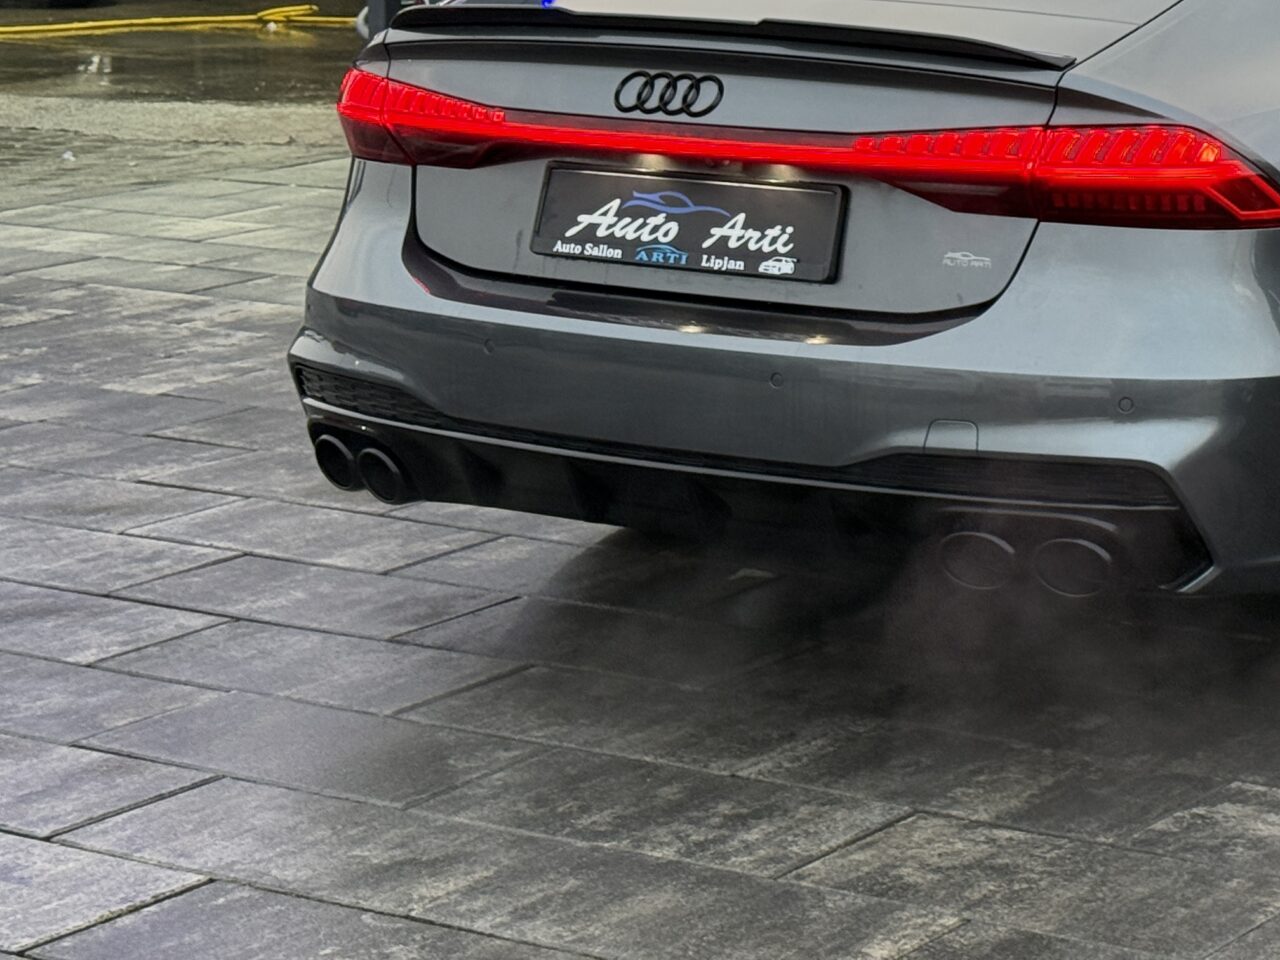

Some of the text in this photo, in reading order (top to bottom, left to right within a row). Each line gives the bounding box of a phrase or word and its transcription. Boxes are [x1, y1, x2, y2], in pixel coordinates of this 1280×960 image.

[565, 198, 796, 254] Auto Arti
[553, 240, 623, 259] Auto Sallon
[635, 250, 689, 265] ARTI
[701, 254, 745, 271] Lipjan
